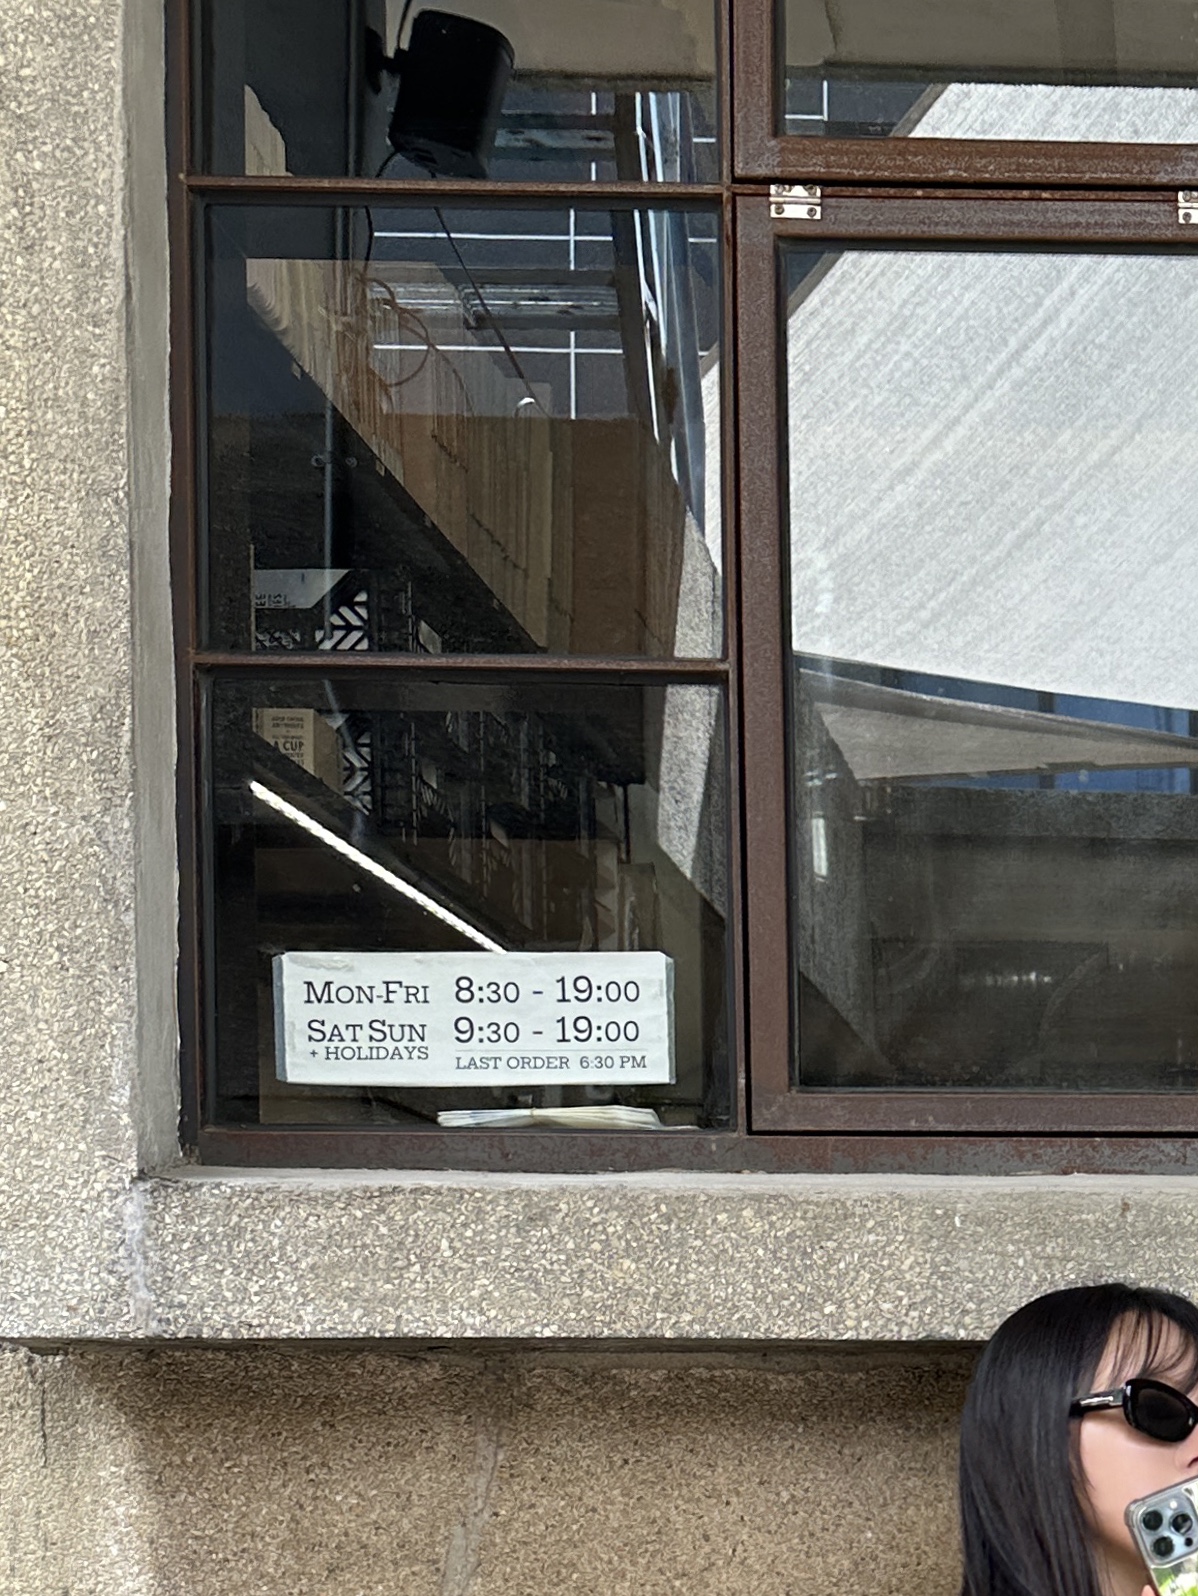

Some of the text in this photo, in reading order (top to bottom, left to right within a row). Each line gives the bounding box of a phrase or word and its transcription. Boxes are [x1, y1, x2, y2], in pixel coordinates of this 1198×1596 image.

[455, 975, 520, 1004] 8:30
[555, 975, 640, 1003] 19:00
[453, 1016, 520, 1044] 9:30
[556, 1015, 640, 1043] 19:00
[324, 1045, 429, 1061] HOLIDAYS
[455, 1055, 647, 1070] LAST ORDER 6:30 PM
